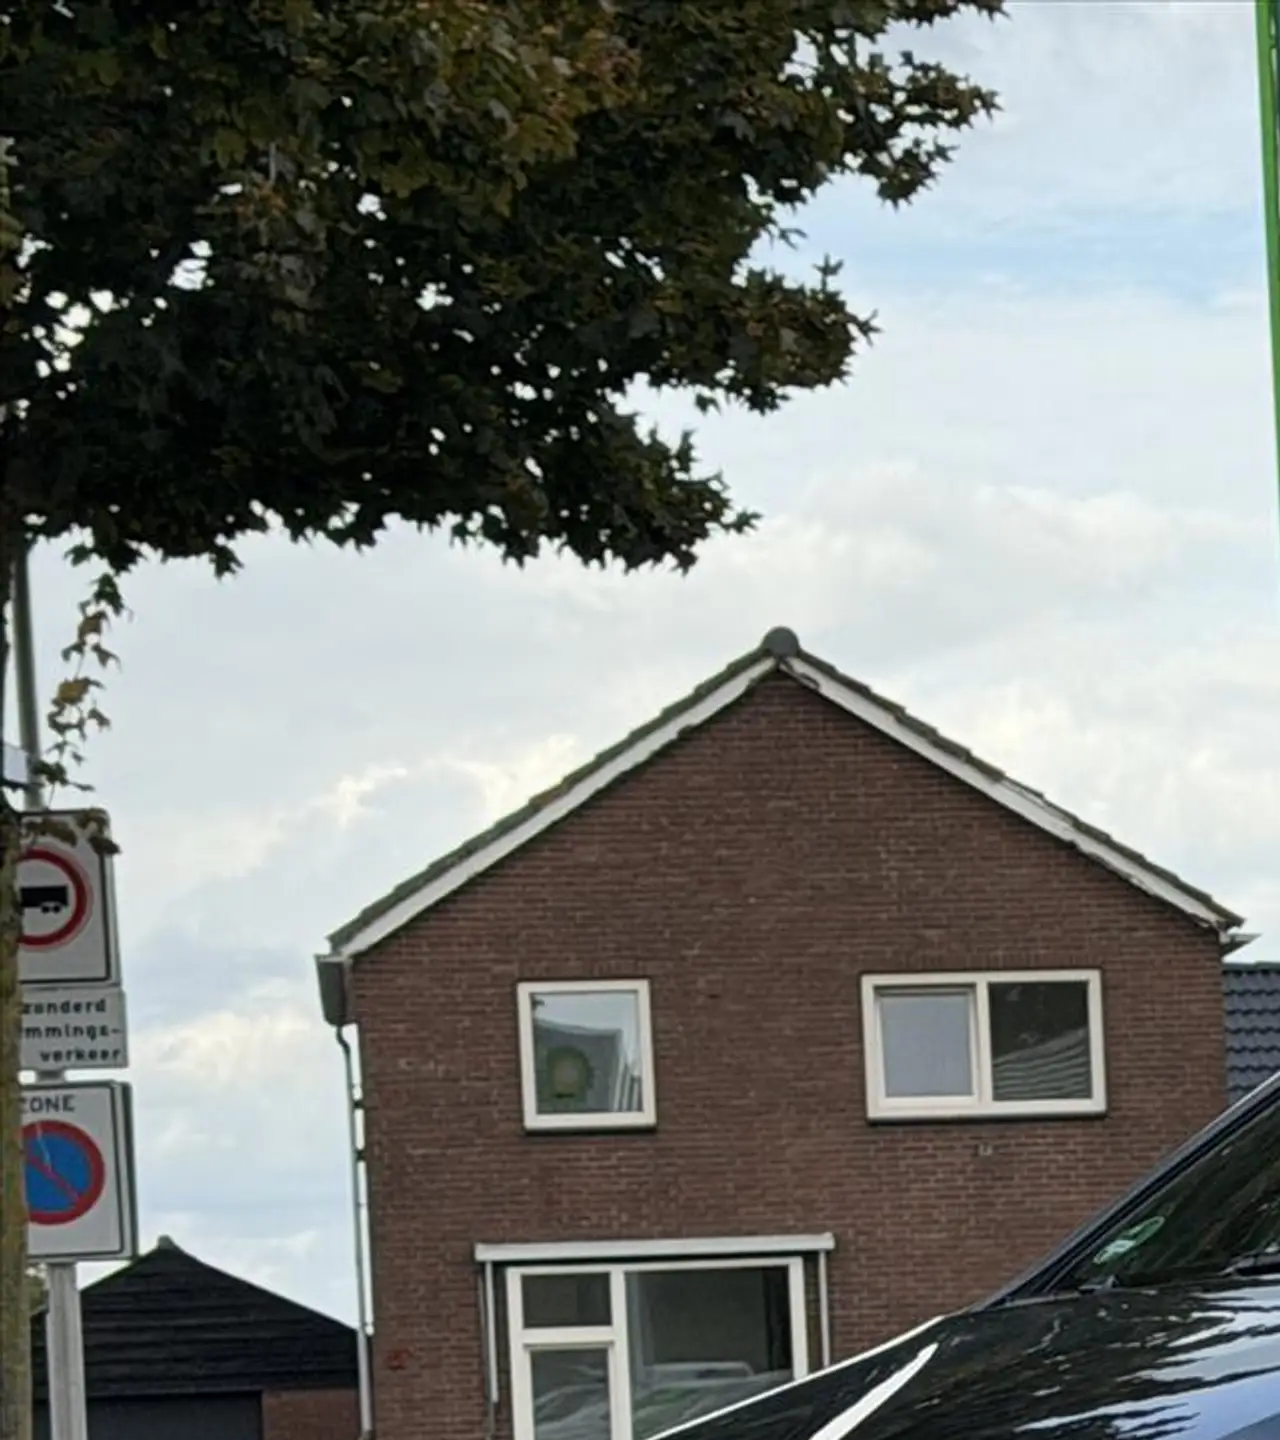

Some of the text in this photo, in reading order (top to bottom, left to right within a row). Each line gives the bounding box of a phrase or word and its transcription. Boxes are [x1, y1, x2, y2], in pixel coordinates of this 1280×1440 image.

[21, 998, 106, 1015] zonderd
[25, 1024, 121, 1041] mmings-
[39, 1047, 120, 1062] verkeer
[21, 1094, 76, 1113] ONE
